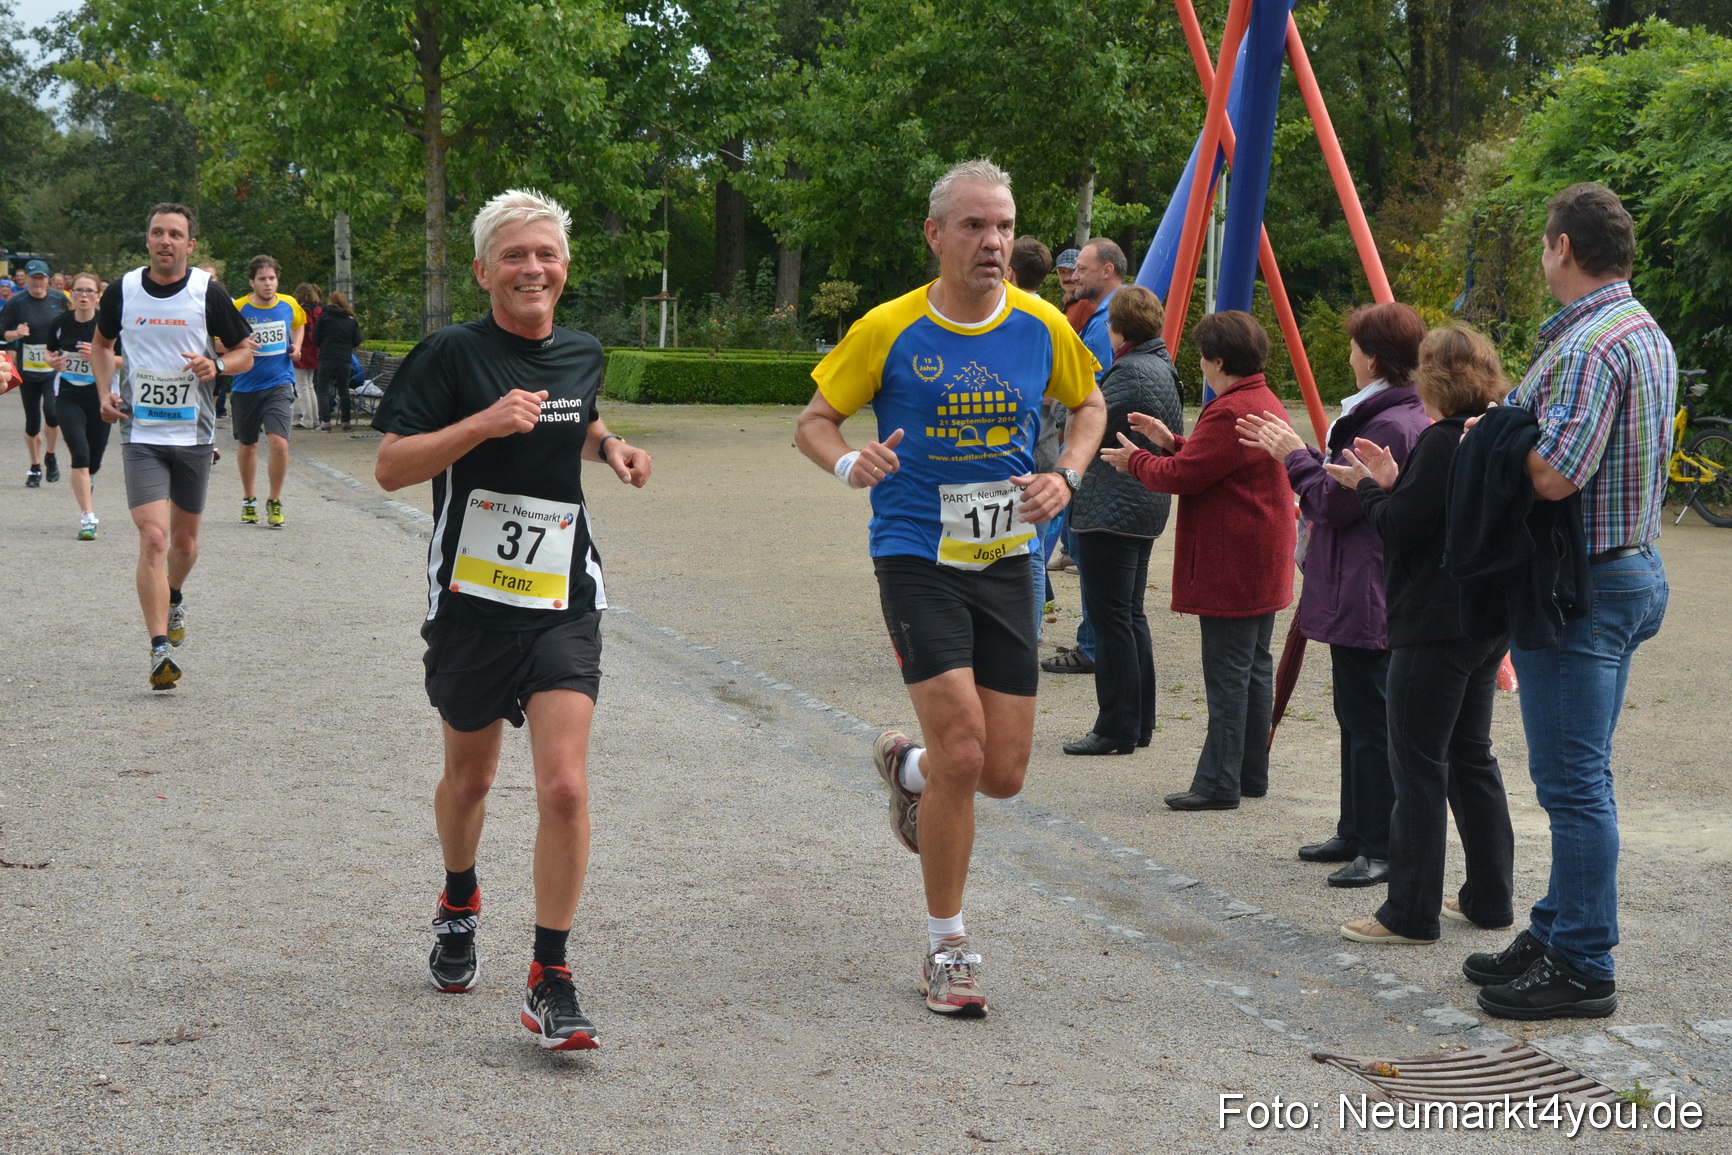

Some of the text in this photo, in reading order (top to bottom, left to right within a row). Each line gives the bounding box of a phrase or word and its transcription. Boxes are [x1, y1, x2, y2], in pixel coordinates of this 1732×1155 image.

[149, 318, 190, 327] KLEBL
[254, 329, 283, 344] 3335
[29, 351, 44, 362] 31
[140, 382, 191, 405] 2537
[539, 398, 582, 409] arathon
[147, 409, 182, 419] Andreas
[536, 411, 581, 423] nsburg
[942, 485, 1017, 503] PARTL Neumarkt
[512, 505, 561, 523] Neumarkt
[964, 498, 1014, 539] 171
[496, 520, 547, 565] 37
[973, 543, 1007, 561] Josef
[492, 569, 533, 592] Franz
